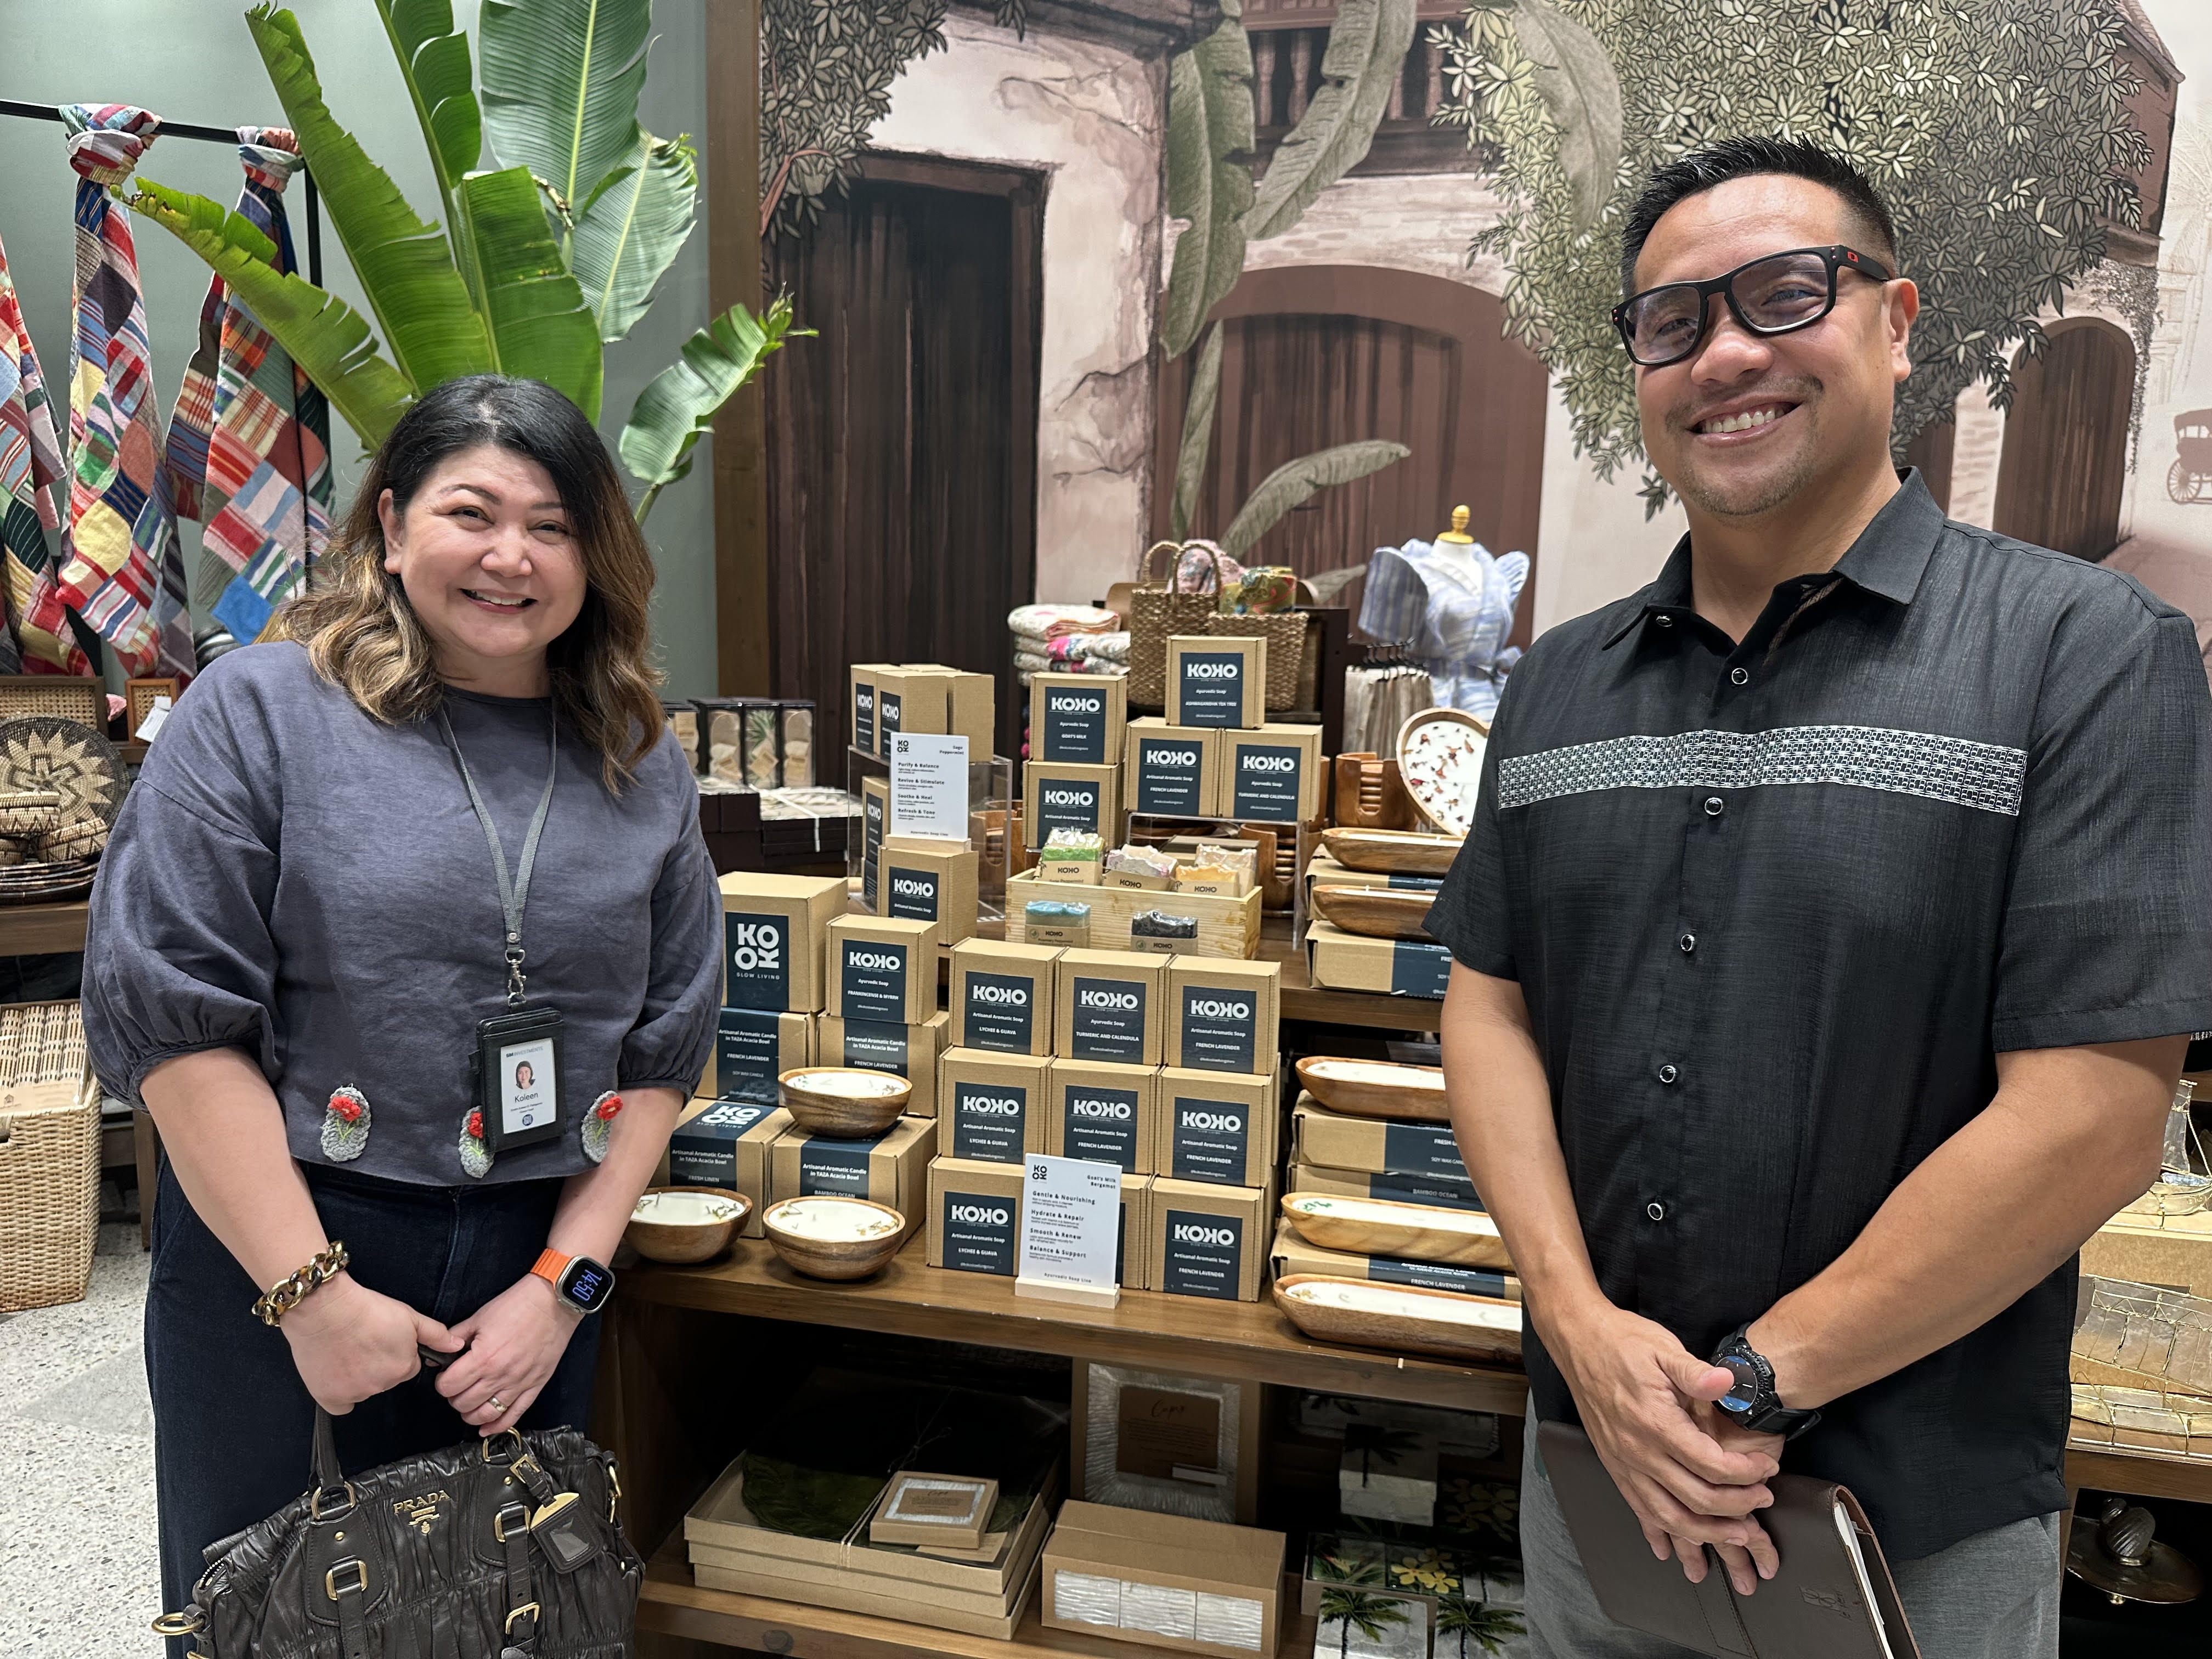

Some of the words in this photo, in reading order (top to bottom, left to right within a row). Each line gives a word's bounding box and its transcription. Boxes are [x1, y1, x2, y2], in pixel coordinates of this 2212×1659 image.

[515, 1092, 539, 1103] Koleen
[1413, 1188, 1437, 1197] BAMBOO
[1061, 1194, 1096, 1205] Nourishing
[1031, 1209, 1056, 1218] Hydrate
[1064, 1213, 1085, 1221] Repair
[1030, 1228, 1054, 1236] Smooth
[1029, 1245, 1054, 1254] Balance
[1062, 1249, 1087, 1259] Support
[1199, 1269, 1225, 1278] LAVENDER
[572, 1269, 602, 1301] 14:50
[1435, 1281, 1466, 1290] LAVENDER
[393, 1489, 450, 1515] PRADA
